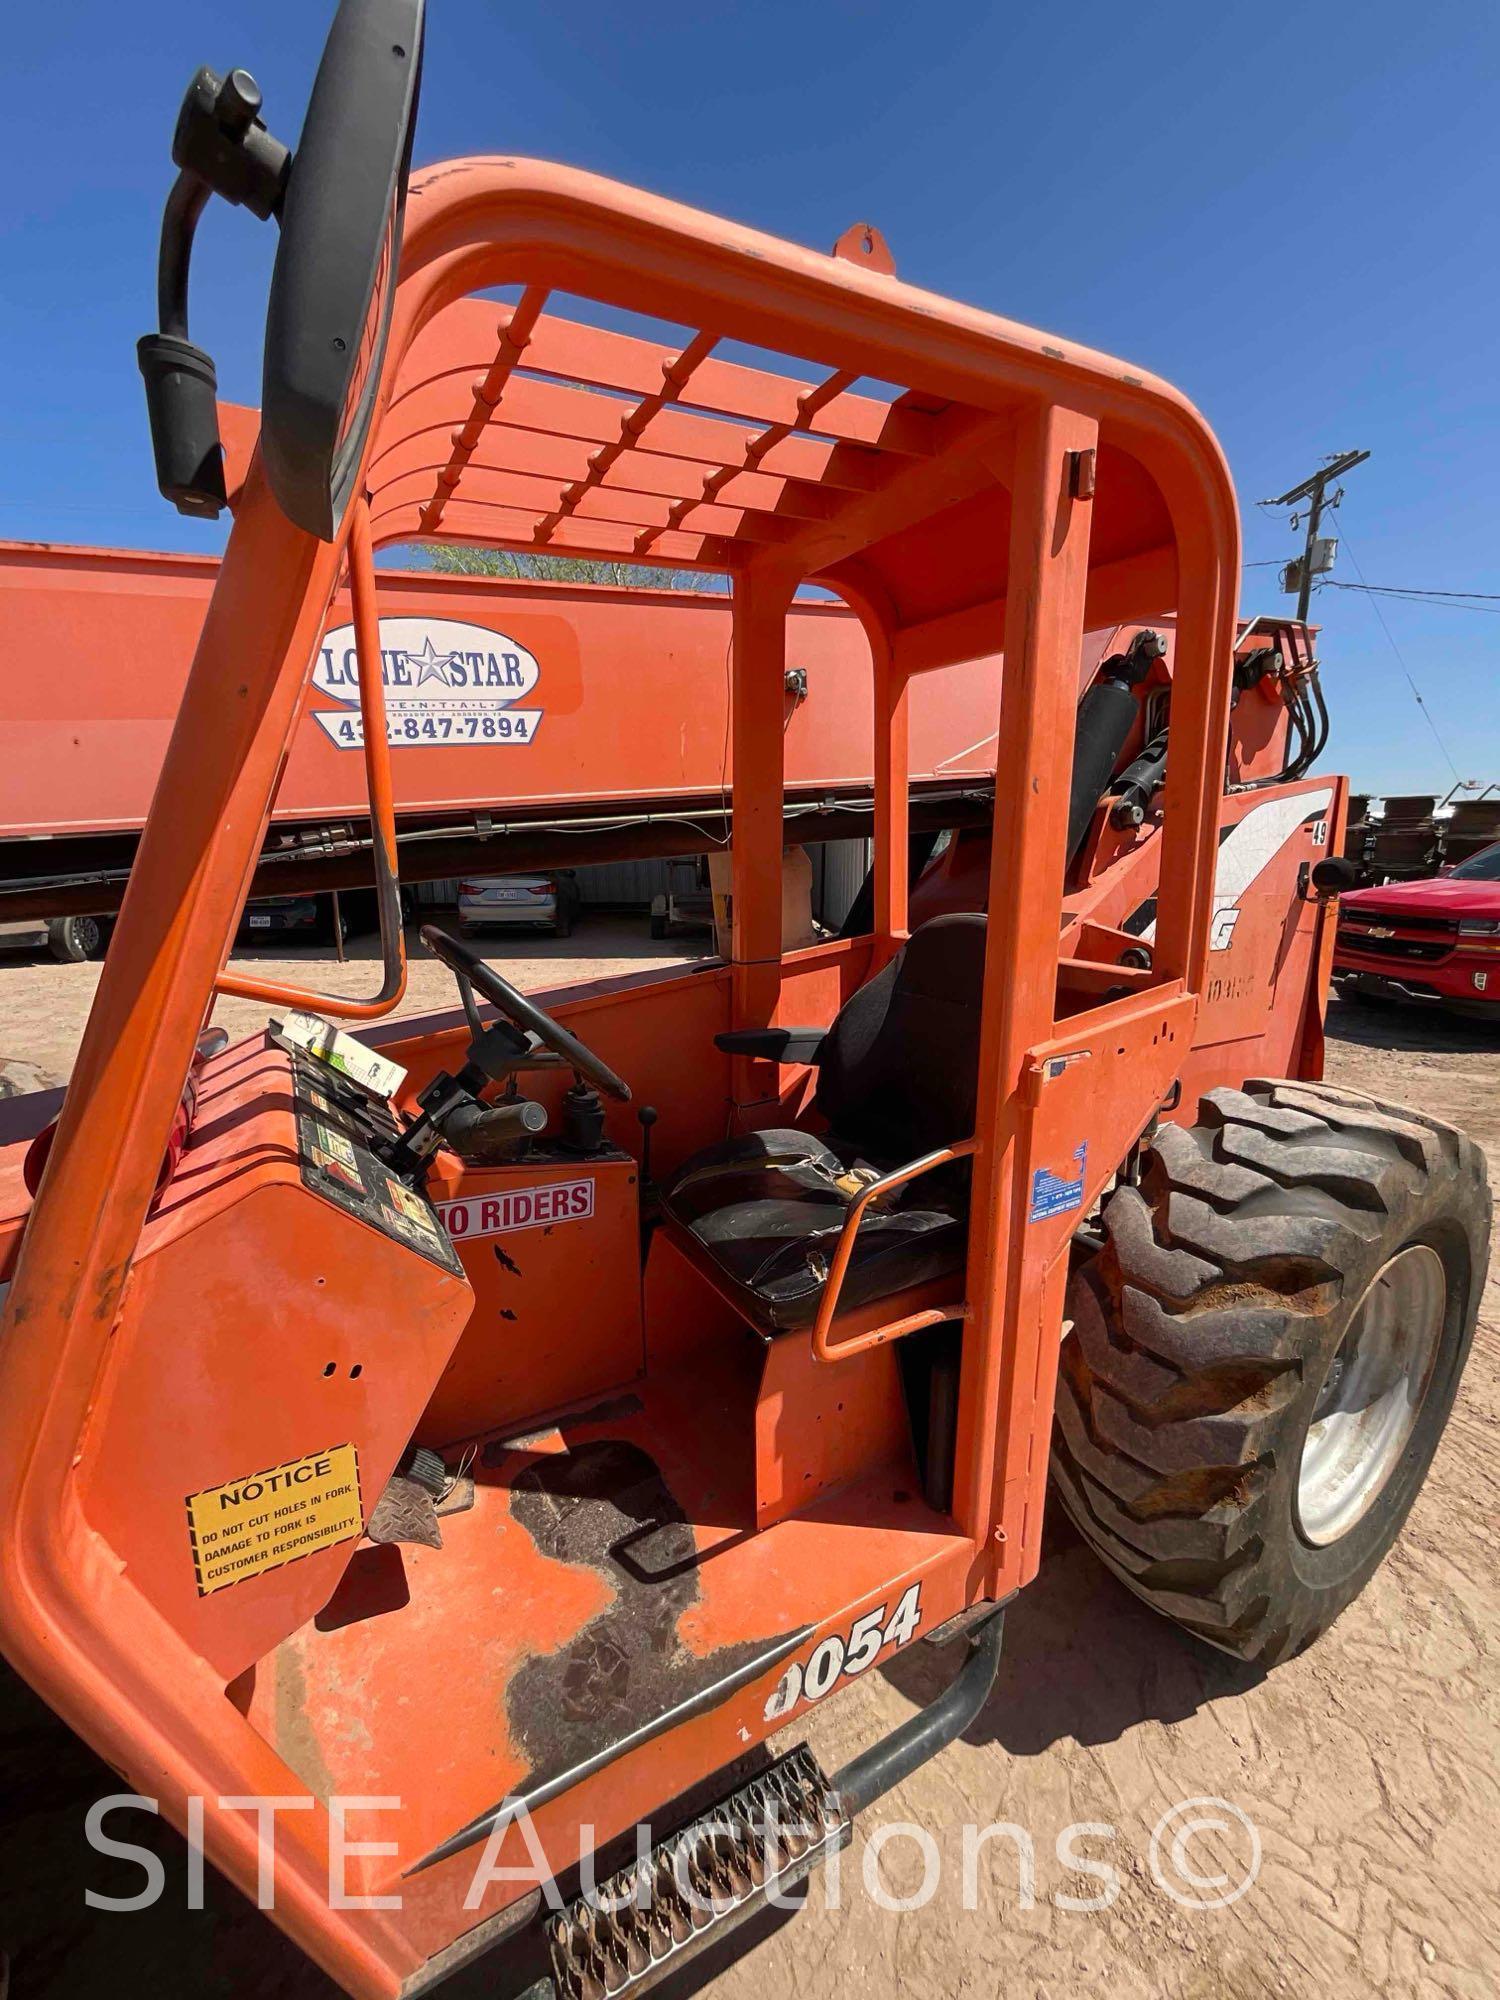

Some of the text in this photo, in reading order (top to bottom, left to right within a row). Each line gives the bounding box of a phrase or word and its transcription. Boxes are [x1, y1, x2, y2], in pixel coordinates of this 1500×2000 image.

[450, 650, 525, 687] STAR
[1313, 821, 1326, 844] 49
[481, 1186, 588, 1230] RIDERS
[219, 1458, 332, 1510] NOTICE
[202, 1484, 355, 1545] DO NOT CUT HOLES IN FORK.
[204, 1514, 316, 1562] DAMAGE TO FORK IS
[207, 1517, 359, 1579] CUSTOMER RESPONSIBILITY.
[740, 1580, 923, 1739] 0054
